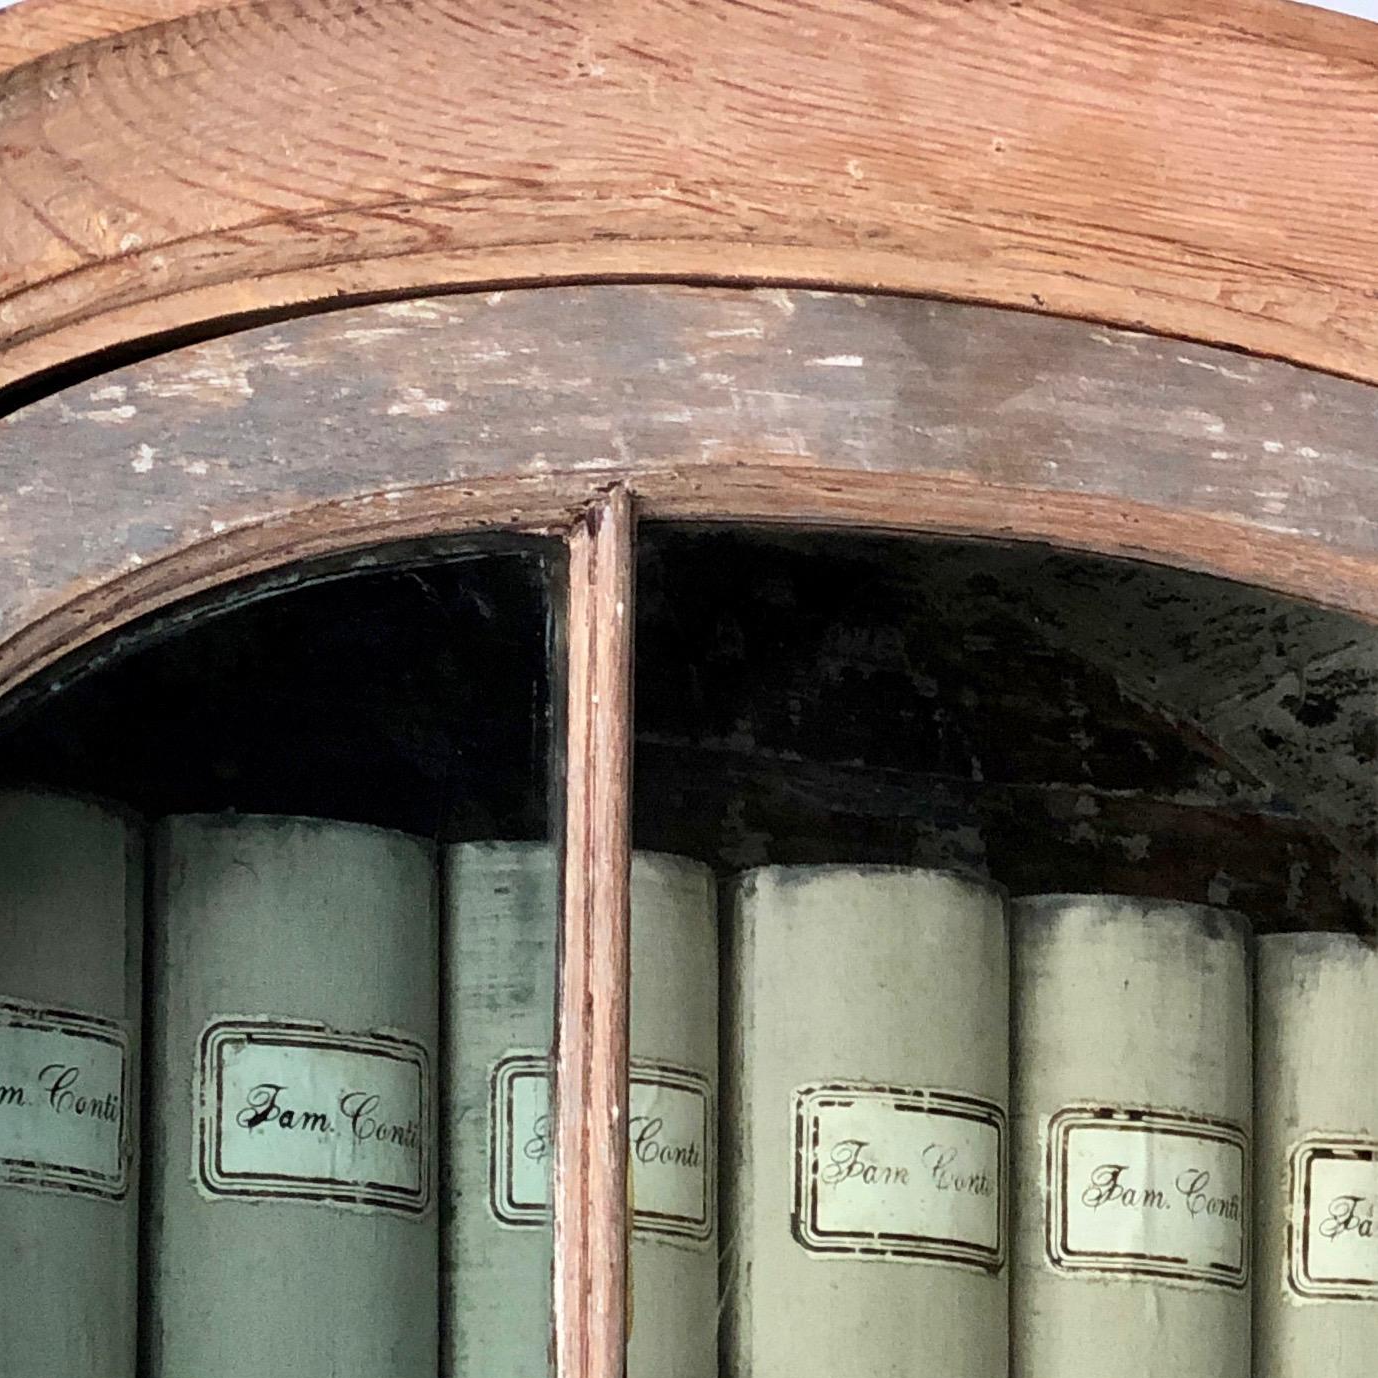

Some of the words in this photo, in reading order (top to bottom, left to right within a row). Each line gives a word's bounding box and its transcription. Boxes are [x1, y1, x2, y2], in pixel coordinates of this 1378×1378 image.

[37, 1063, 120, 1123] Conti
[235, 1082, 335, 1135] Fam.
[340, 1090, 421, 1150] Conti
[628, 1114, 701, 1169] Conti
[1080, 1163, 1172, 1213] Fam.
[1175, 1167, 1240, 1221] Conti
